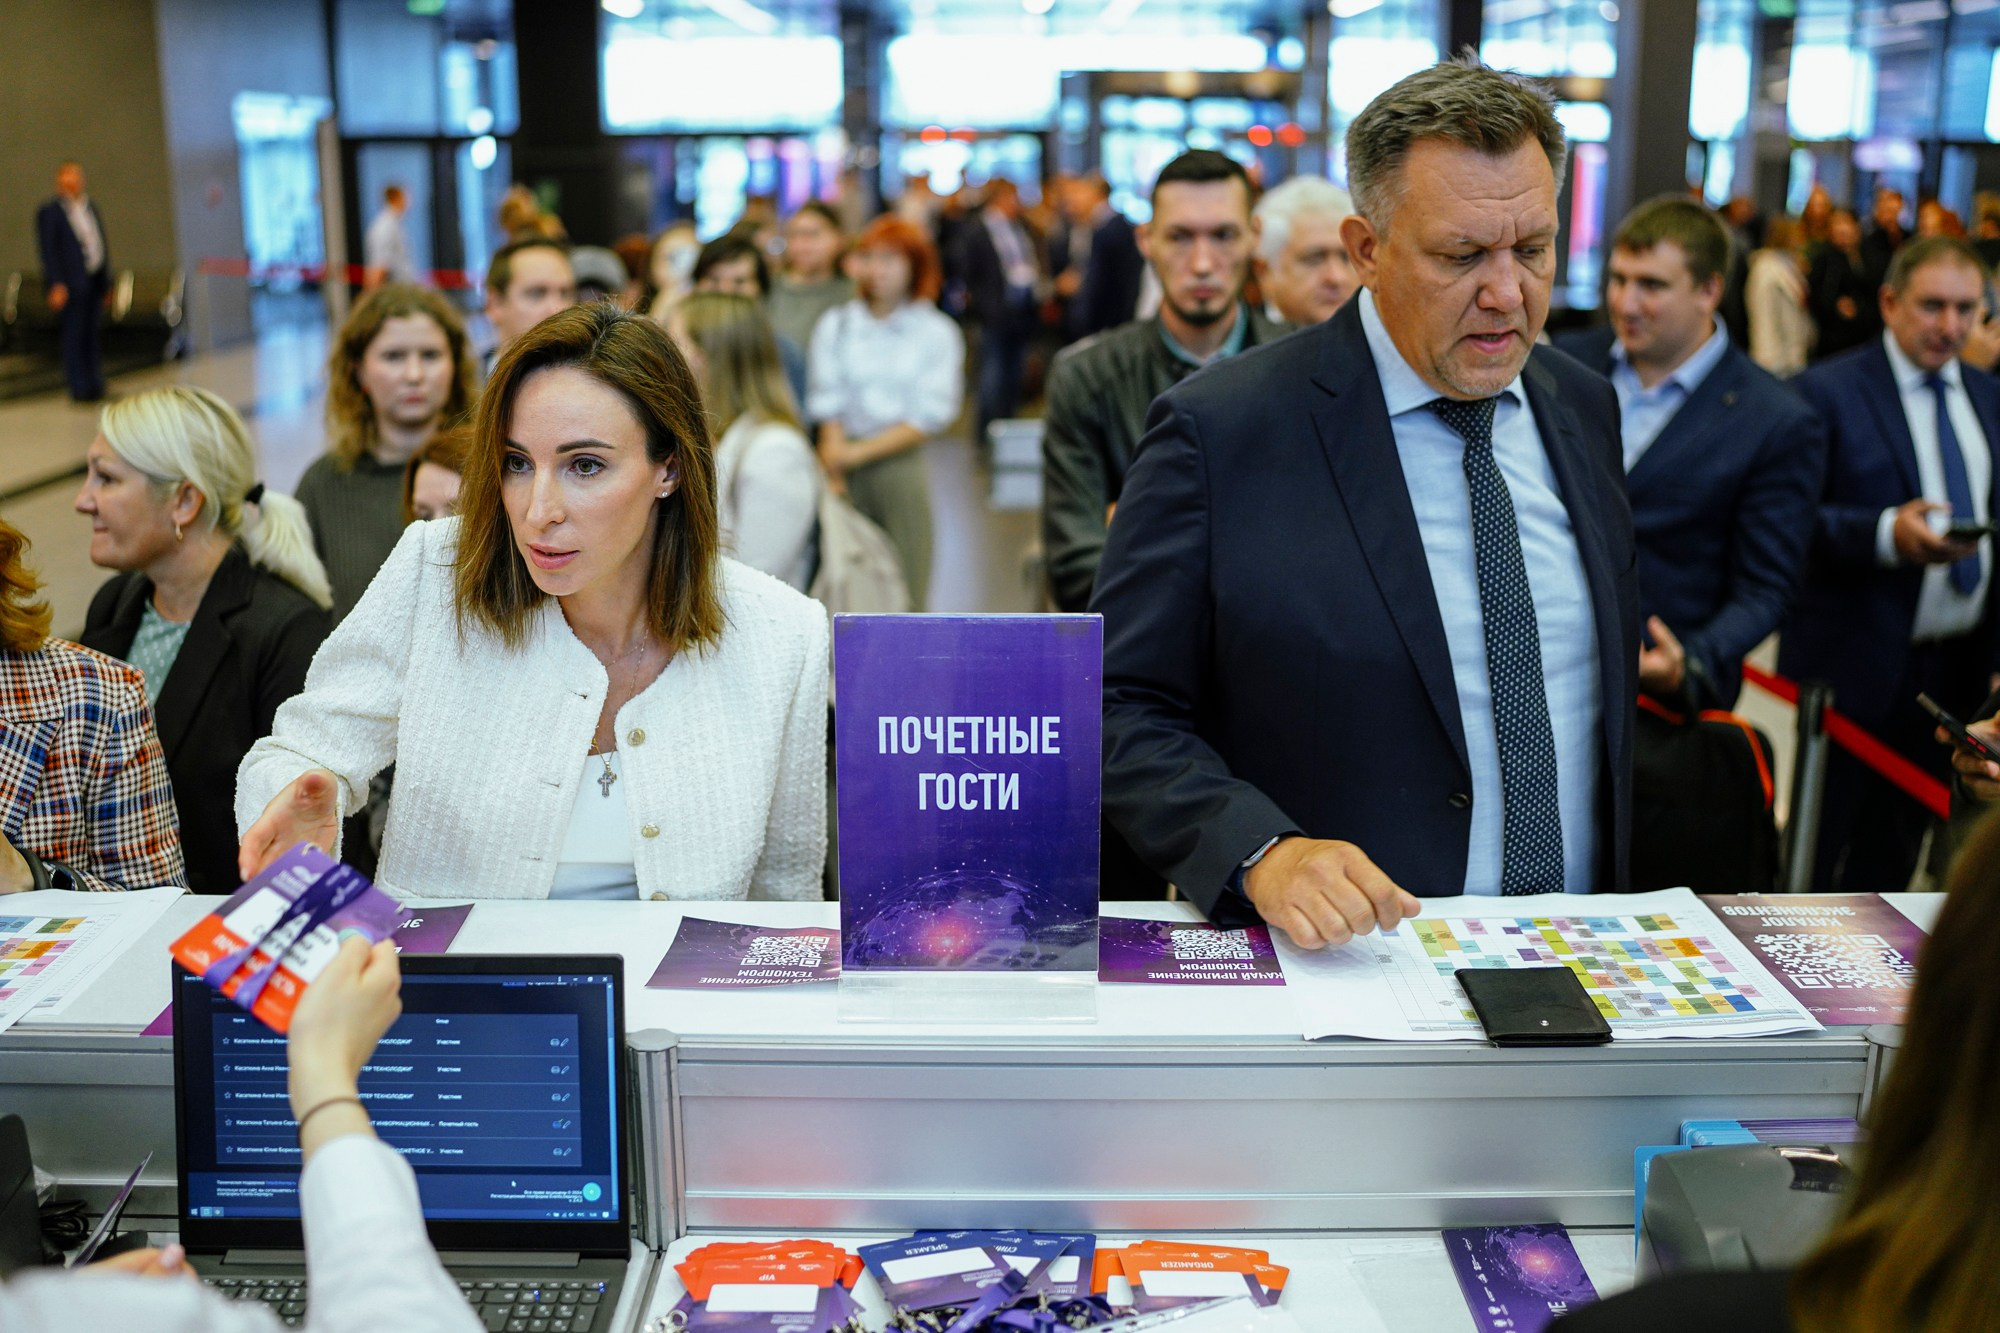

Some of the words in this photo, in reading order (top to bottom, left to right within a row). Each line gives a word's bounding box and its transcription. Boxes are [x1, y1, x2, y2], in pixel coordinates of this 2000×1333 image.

[878, 716, 1060, 754] ПОЧЕТНЫЕ
[918, 773, 1020, 810] ГОСТИ
[1721, 906, 1856, 916] ЭКСПОНЕНТОВ
[1762, 917, 1842, 927] КАТАЛОГ
[1180, 963, 1256, 971] ТЕХНОПРОМ
[737, 969, 813, 978] ТЕХНОПРОМ
[904, 1243, 949, 1255] SPEAKER
[1160, 1260, 1214, 1269] ORGANIZER
[758, 1273, 776, 1281] VIP
